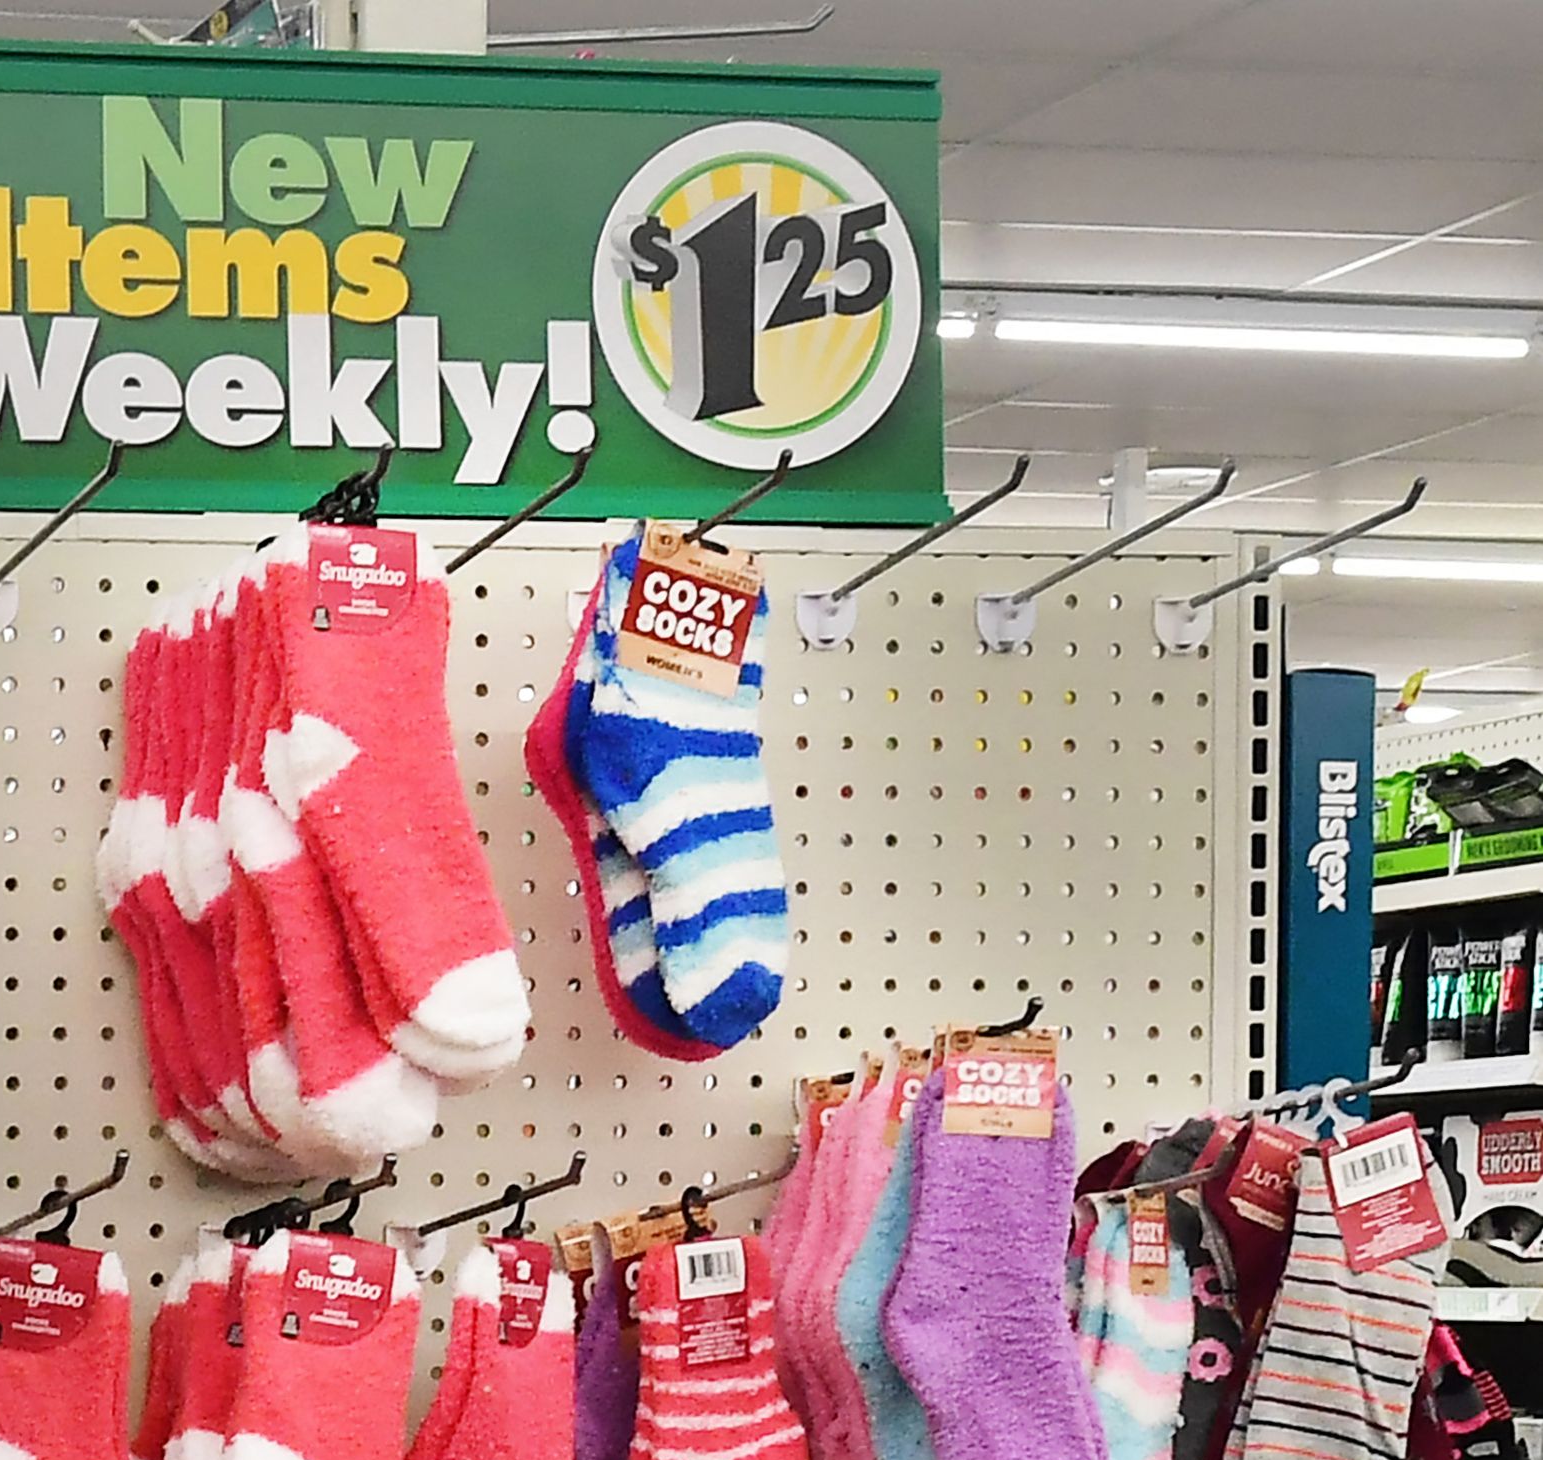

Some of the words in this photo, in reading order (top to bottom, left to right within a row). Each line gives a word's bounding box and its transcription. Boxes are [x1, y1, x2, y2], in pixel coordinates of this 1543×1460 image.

[103, 94, 474, 229] New
[319, 561, 407, 590] Snugadoo
[643, 571, 746, 627] COZY
[635, 604, 734, 657] SOCKS
[1306, 760, 1357, 914] Blistex
[956, 1060, 1045, 1086] COZY
[957, 1084, 1043, 1106] SOCKS
[1481, 1153, 1541, 1175] SMOOTH
[294, 1268, 382, 1301] Snugadoo
